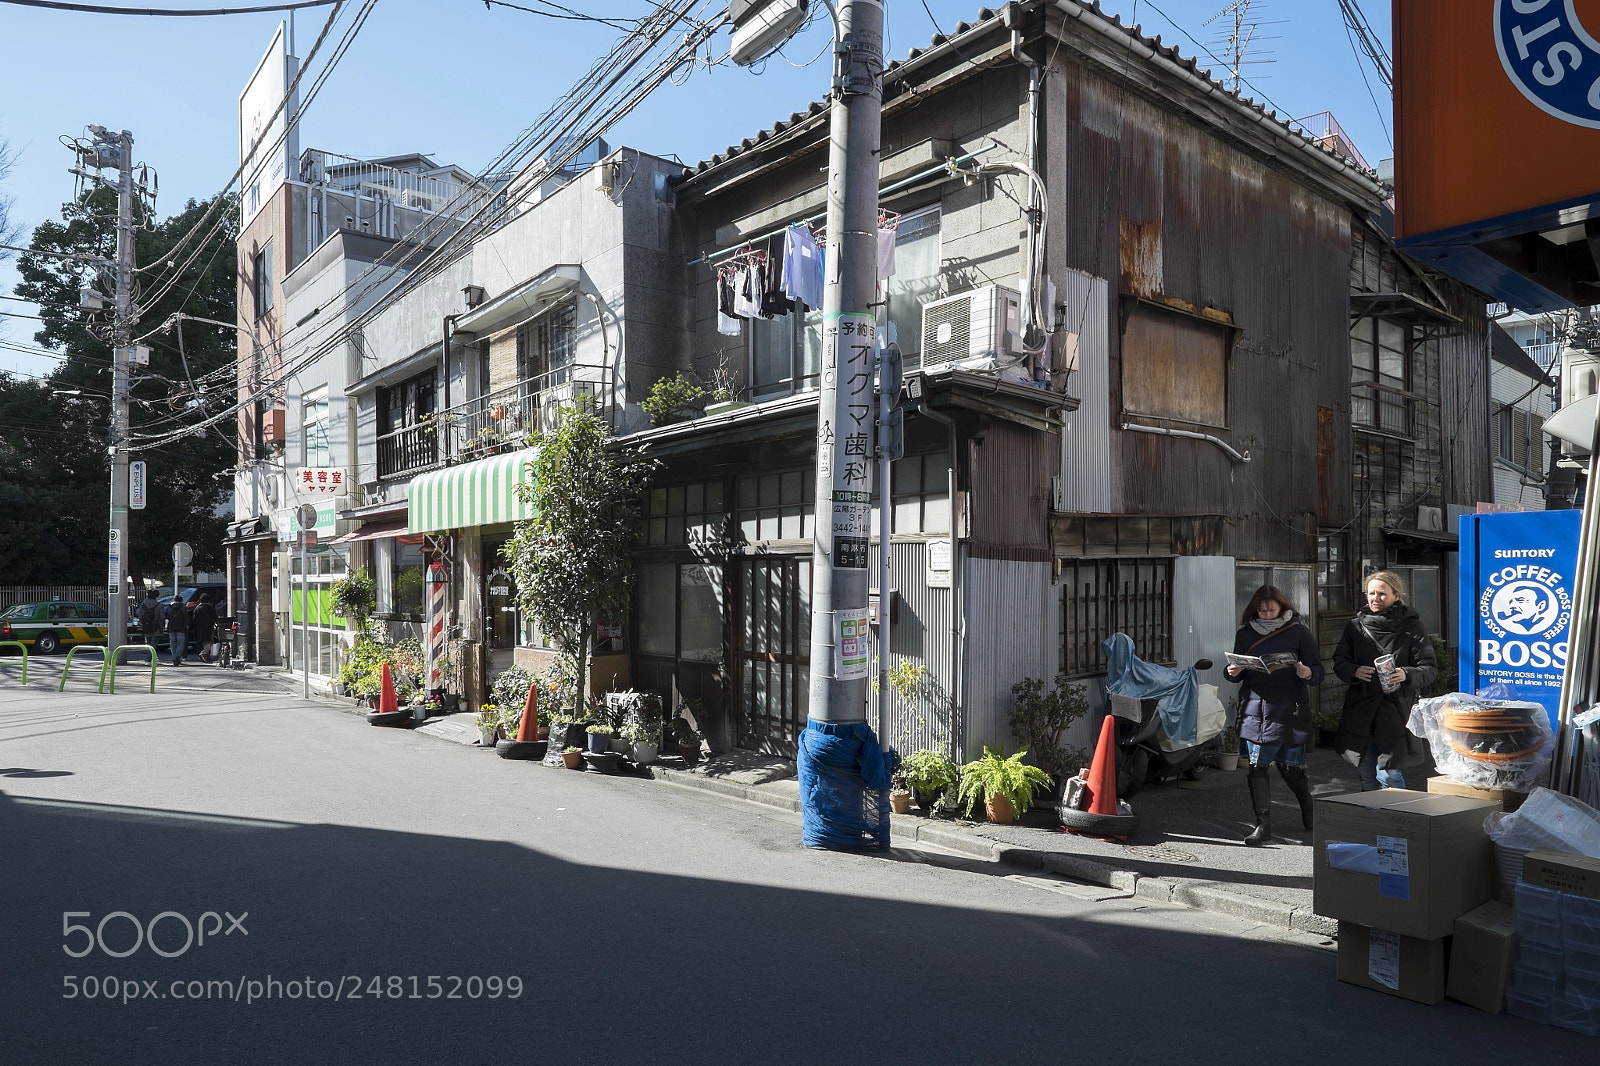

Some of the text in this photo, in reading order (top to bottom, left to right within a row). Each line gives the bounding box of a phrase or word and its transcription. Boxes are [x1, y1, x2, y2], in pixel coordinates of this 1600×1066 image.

[842, 342, 872, 487] オグマ歯科
[303, 470, 342, 484] 美容室
[308, 485, 337, 493] ヤマダ
[841, 555, 865, 565] 5-15
[1494, 548, 1555, 558] SUNTORY
[1489, 564, 1562, 588] COFFEE
[1480, 586, 1506, 639] BOSS COFFEE
[1543, 586, 1571, 640] BOSS COFFEE
[1479, 639, 1569, 669] BOSS
[1478, 669, 1513, 677] SUNTORY
[1514, 671, 1535, 679] BOSS
